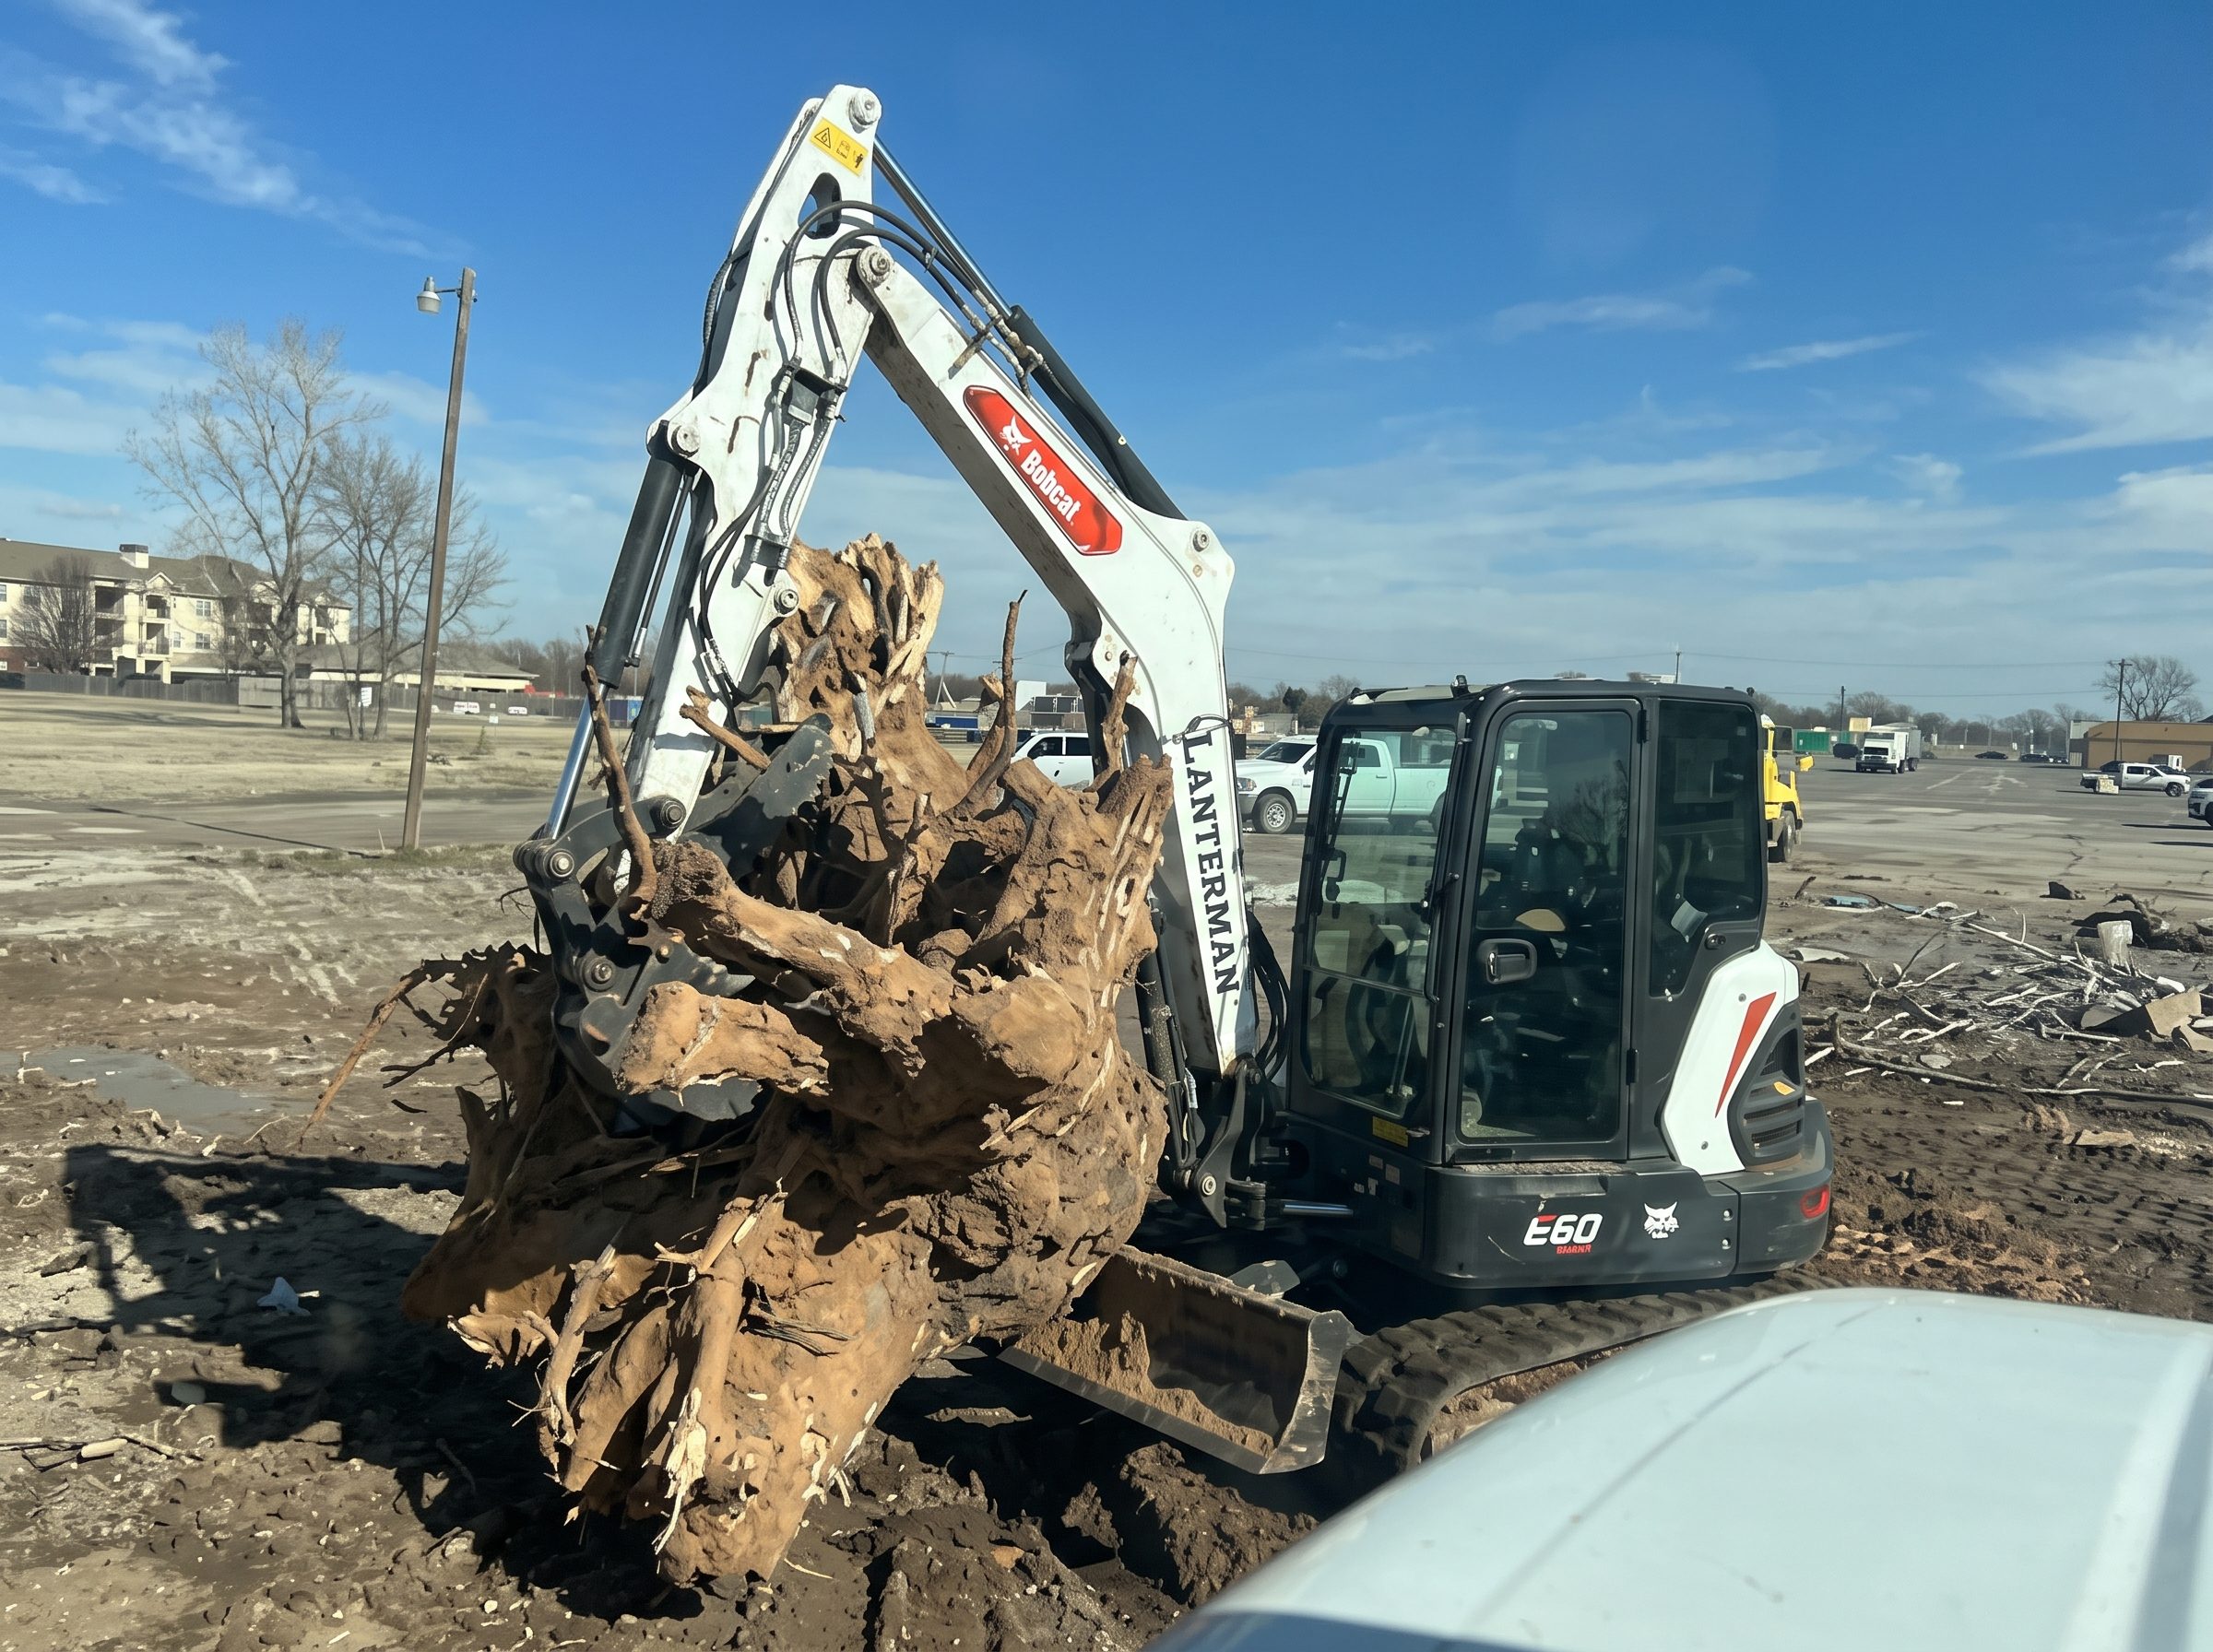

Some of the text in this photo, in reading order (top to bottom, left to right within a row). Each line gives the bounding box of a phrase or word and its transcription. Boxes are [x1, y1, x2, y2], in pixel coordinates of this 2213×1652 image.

[1020, 449, 1082, 523] Bobcat
[1182, 730, 1240, 995] LANTERMAN
[1523, 1213, 1604, 1246] E60
